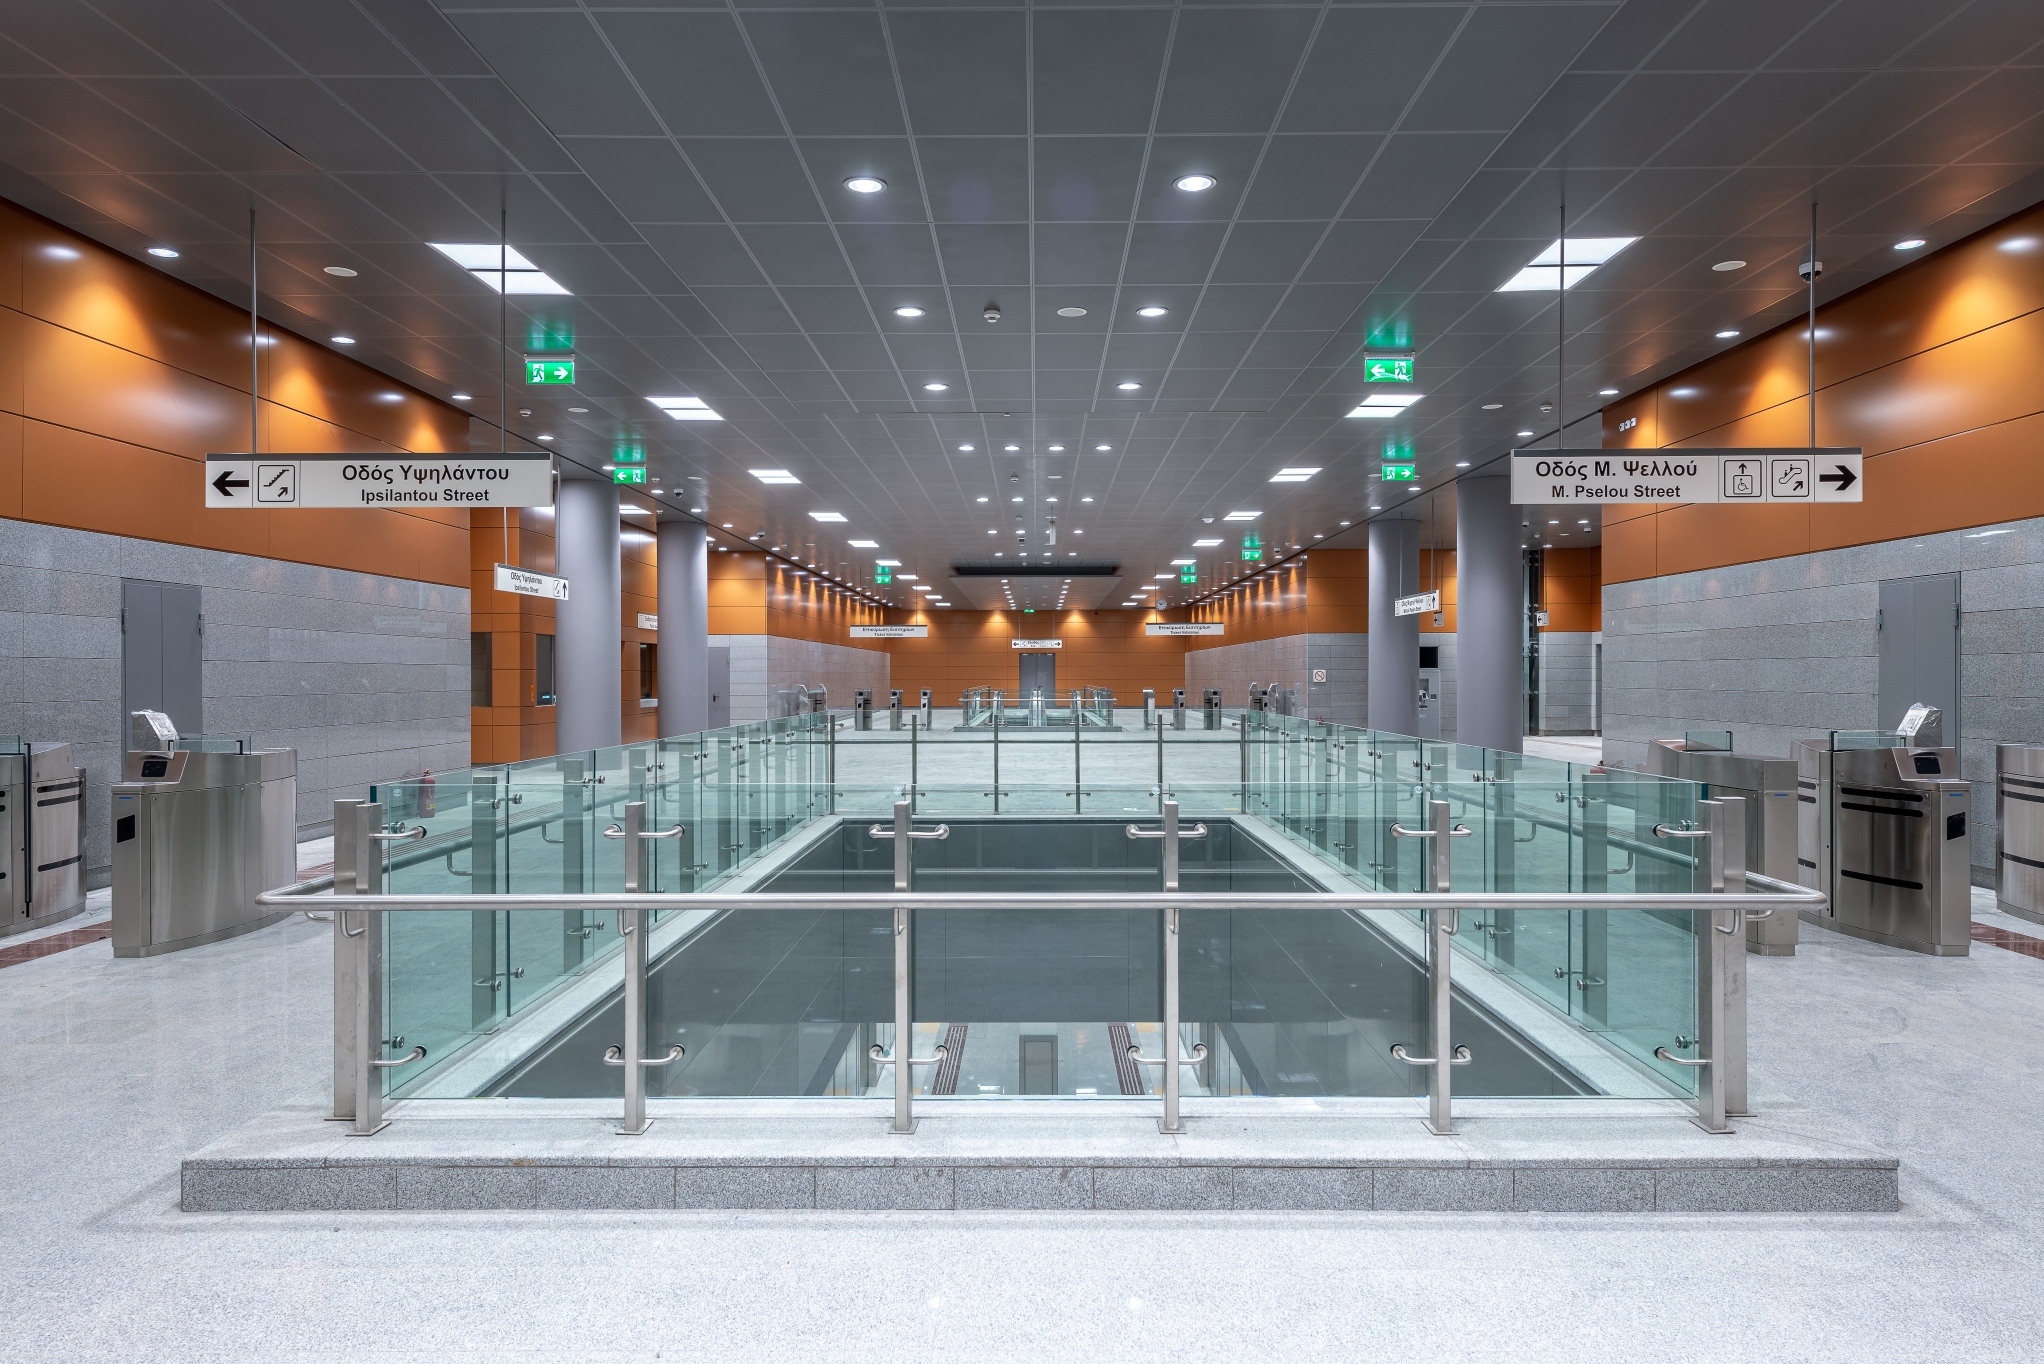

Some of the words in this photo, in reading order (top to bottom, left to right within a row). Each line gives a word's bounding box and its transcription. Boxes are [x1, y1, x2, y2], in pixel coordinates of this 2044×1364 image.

[342, 464, 394, 485] Οδός
[399, 464, 509, 484] Υψηλάντου
[1535, 459, 1588, 480] Οδός
[1623, 459, 1698, 477] Ψελλού
[361, 488, 438, 504] Ipsilantou
[442, 488, 490, 502] Street
[1551, 485, 1570, 498] M.
[1575, 484, 1629, 498] Pselou
[1633, 484, 1681, 498] Street
